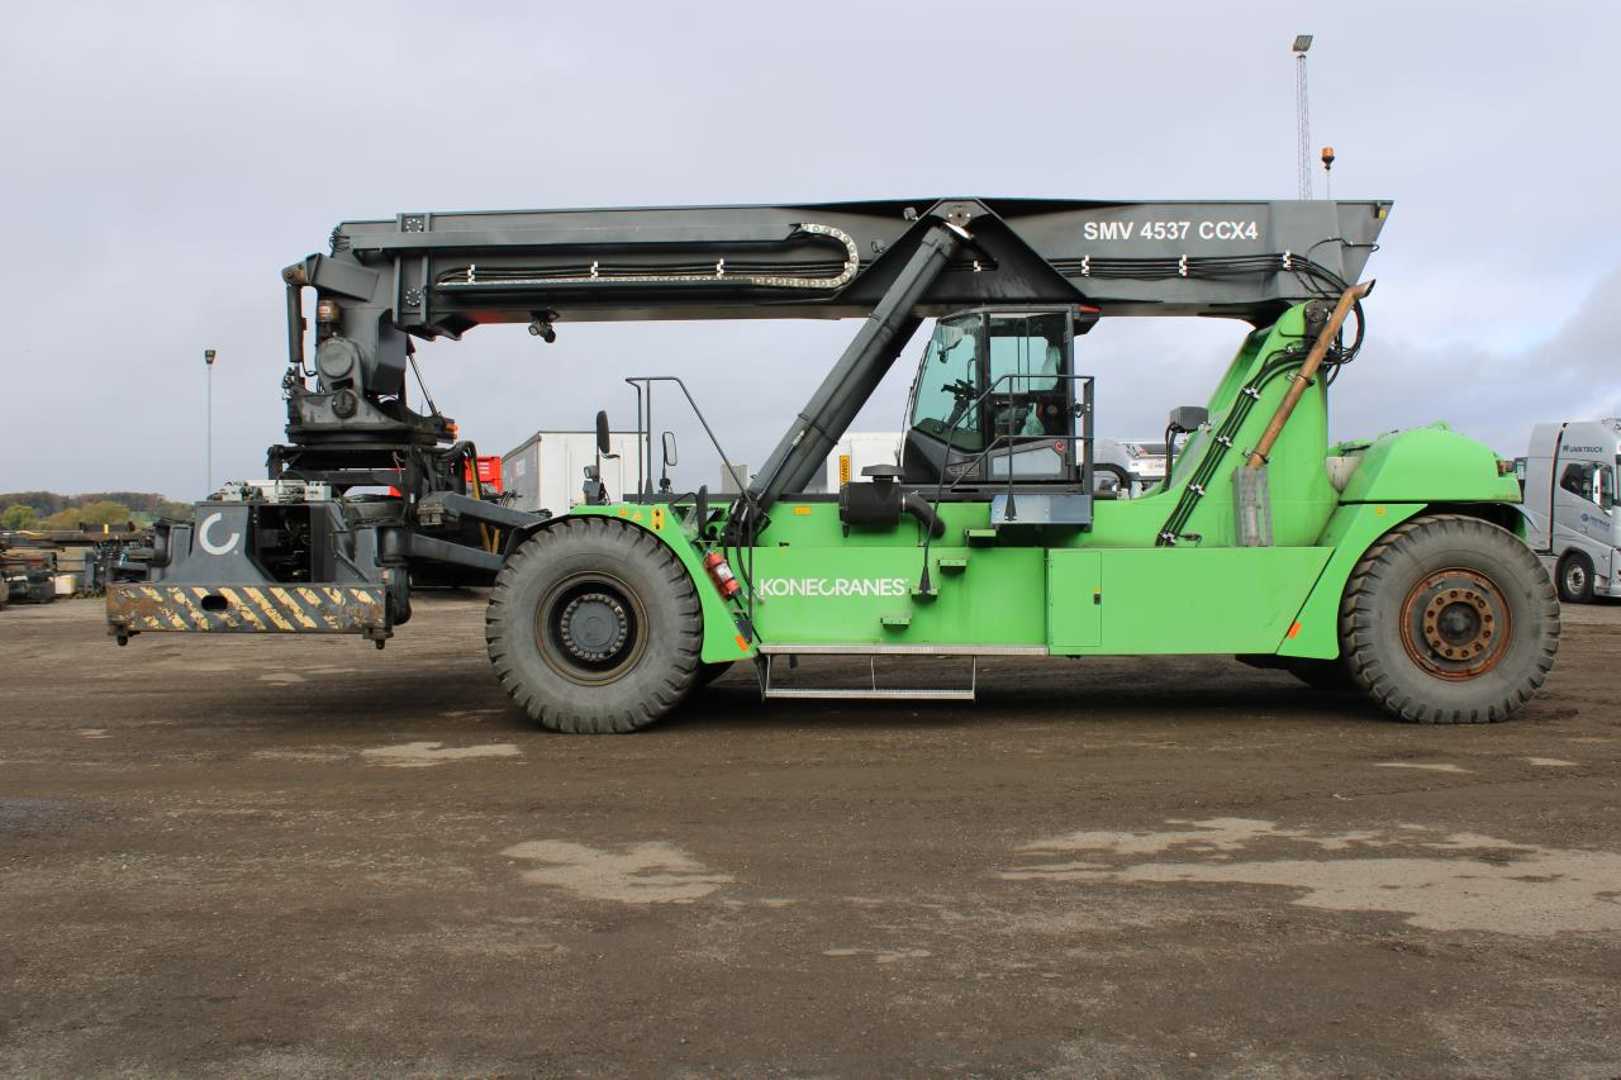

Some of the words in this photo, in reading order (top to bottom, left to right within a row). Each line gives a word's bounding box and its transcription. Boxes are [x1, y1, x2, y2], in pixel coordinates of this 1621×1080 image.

[1083, 221, 1133, 240] SMV
[1140, 220, 1190, 240] 4537
[1198, 220, 1259, 240] CCX4
[760, 577, 906, 597] KONECRANES
